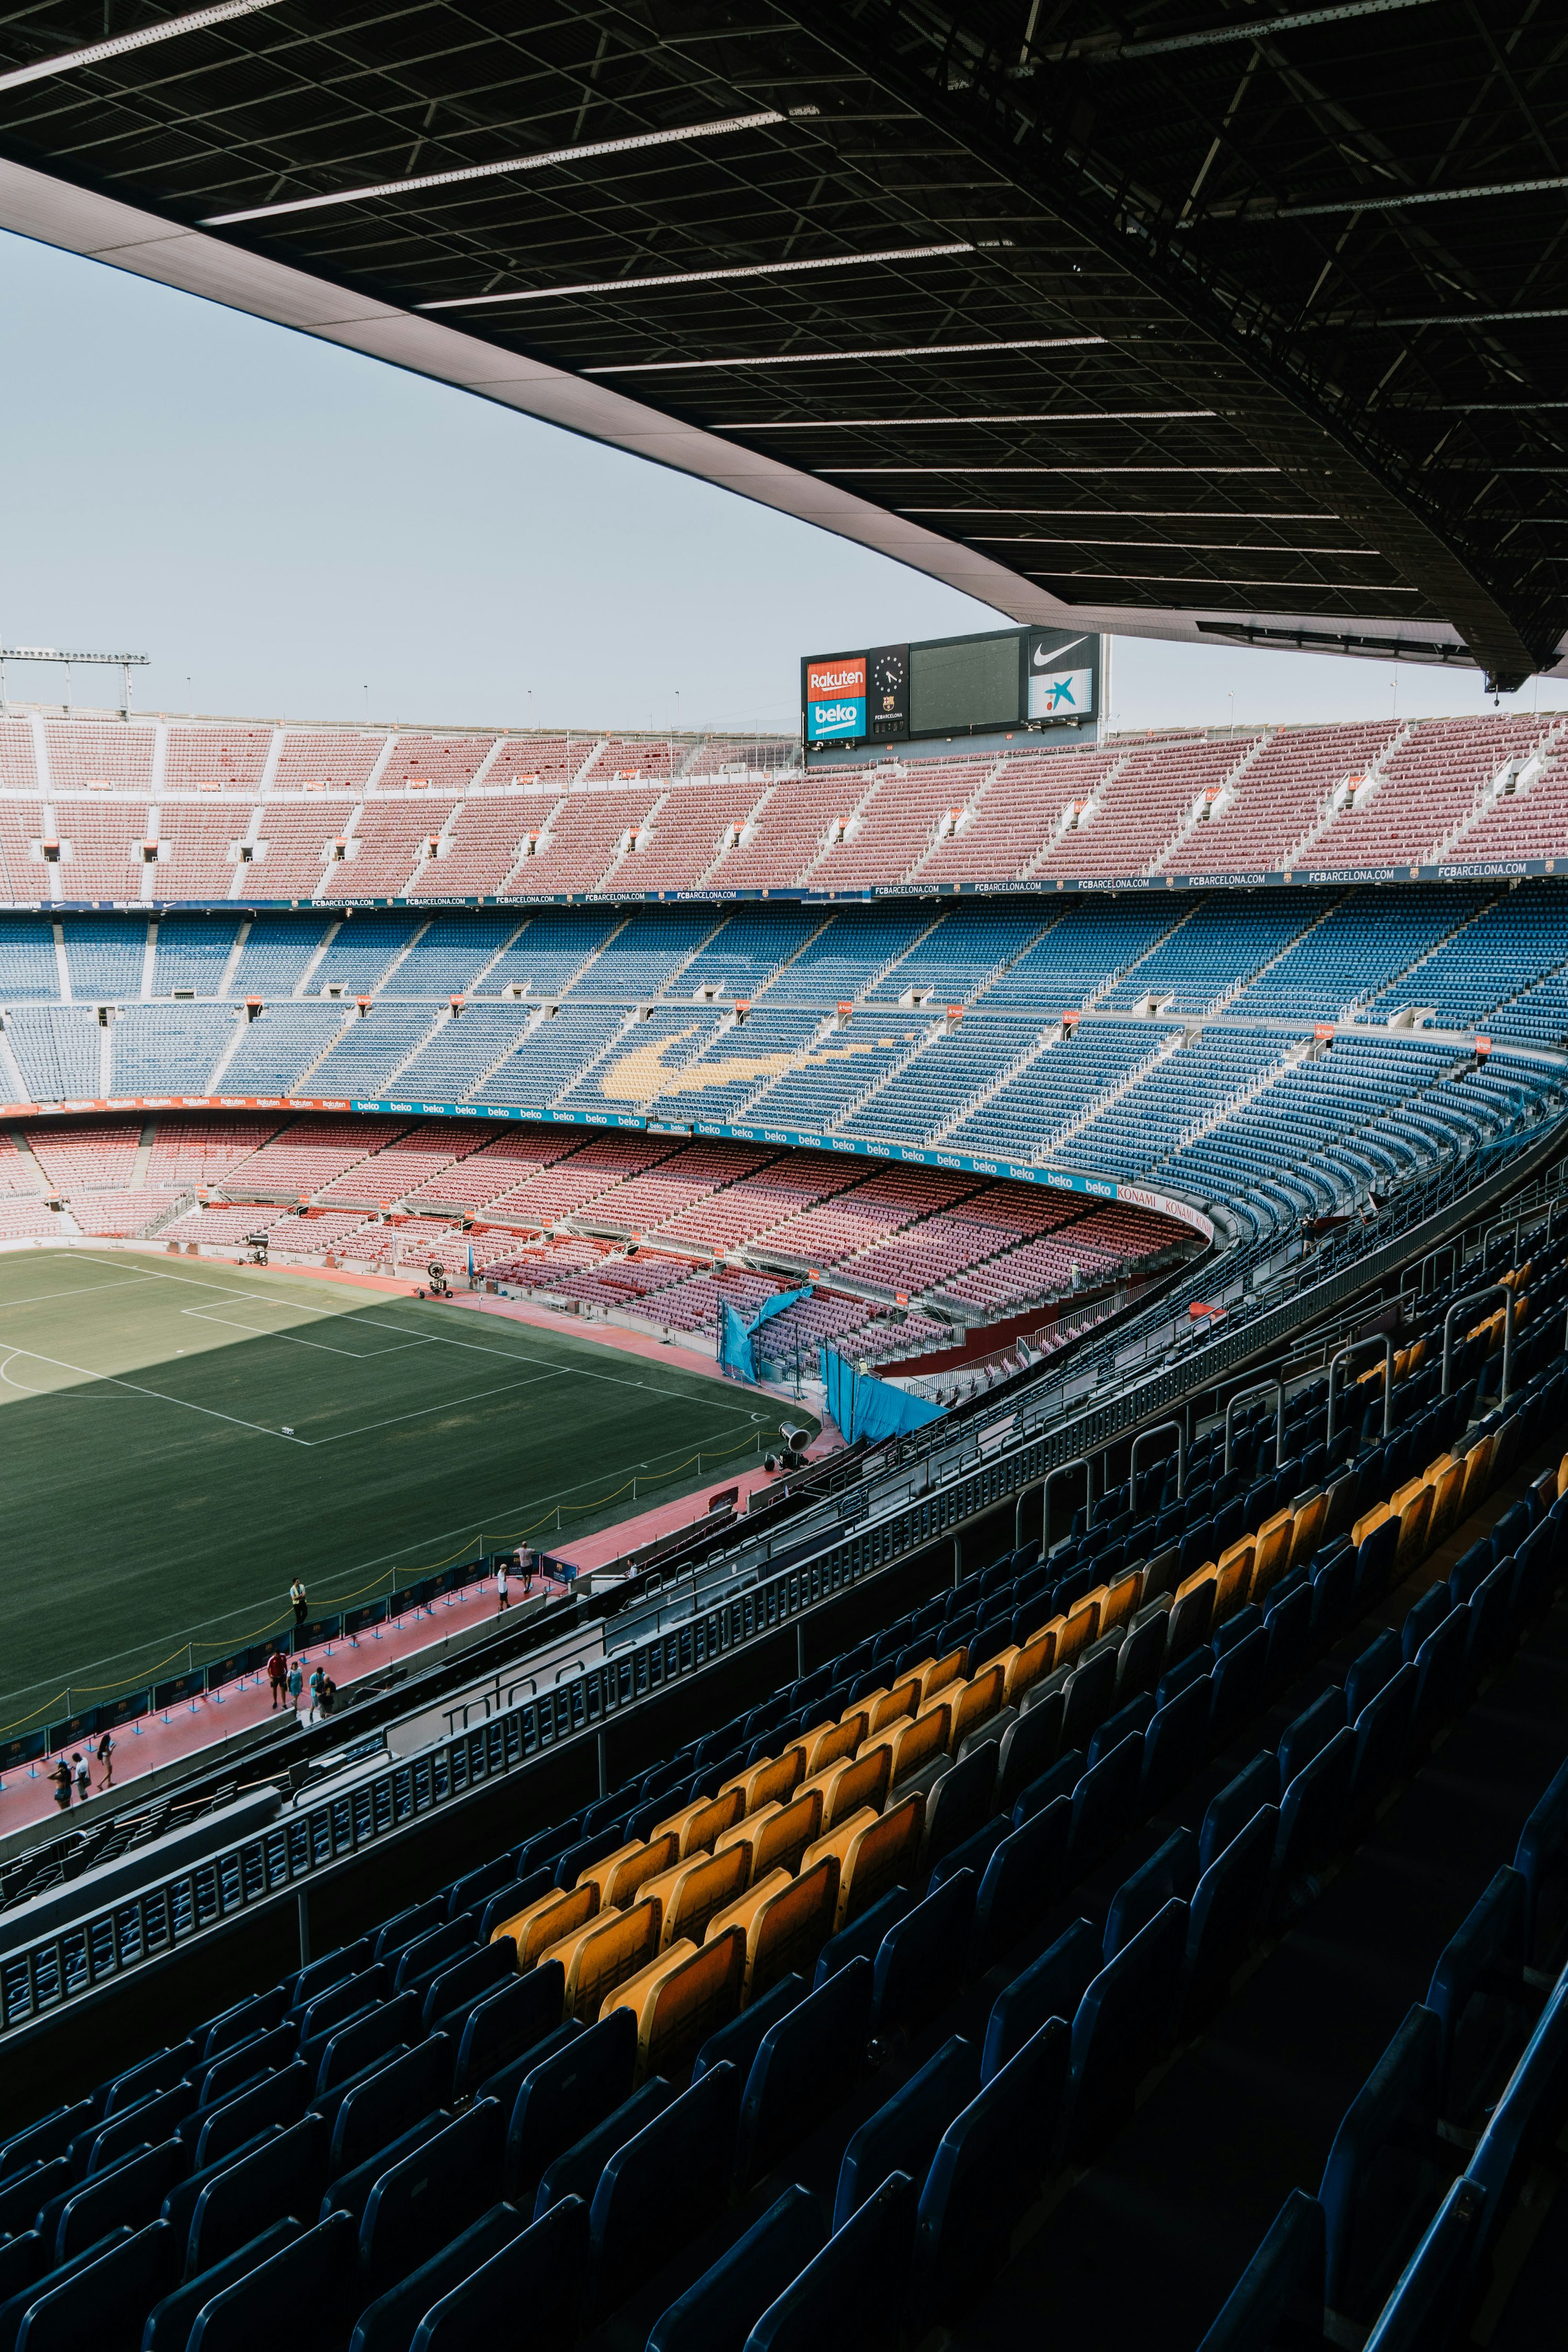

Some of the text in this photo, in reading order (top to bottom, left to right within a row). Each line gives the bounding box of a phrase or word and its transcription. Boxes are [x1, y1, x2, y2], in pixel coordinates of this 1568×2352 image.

[811, 671, 862, 688] Rakuten
[816, 705, 857, 722] beko
[1308, 869, 1393, 881] FCBARCELONA.COM
[1438, 863, 1526, 877] FCBARCELONA.COM
[975, 881, 1041, 891] FCBARCELONA.COM
[1078, 878, 1149, 889] FCBARCELONA.COM
[1189, 874, 1265, 886] FCBARCELONA.COM
[875, 885, 938, 894] FCBARCELONA.COM
[585, 893, 644, 901] FCBARCELONA.COM
[64, 1100, 95, 1110] Rakuten
[106, 1098, 136, 1107] Rakuten
[390, 1103, 412, 1111] beko
[423, 1104, 444, 1113] beko
[456, 1106, 477, 1114] beko
[488, 1108, 509, 1116] beko
[521, 1108, 542, 1119] beko
[554, 1112, 574, 1121] beko
[586, 1113, 607, 1123] beko
[618, 1116, 640, 1126] beko
[699, 1123, 720, 1135] beko
[732, 1127, 753, 1138] beko
[765, 1129, 787, 1142] beko
[799, 1134, 821, 1146] beko
[833, 1138, 855, 1150] beko
[867, 1143, 890, 1155] beko
[902, 1147, 925, 1161] beko
[938, 1154, 960, 1167] beko
[973, 1159, 997, 1173] beko
[1010, 1165, 1034, 1180] beko
[1048, 1173, 1072, 1187] beko
[1086, 1180, 1111, 1195] beko
[1117, 1187, 1156, 1207] KONAMI
[1166, 1200, 1193, 1223] KONAMI
